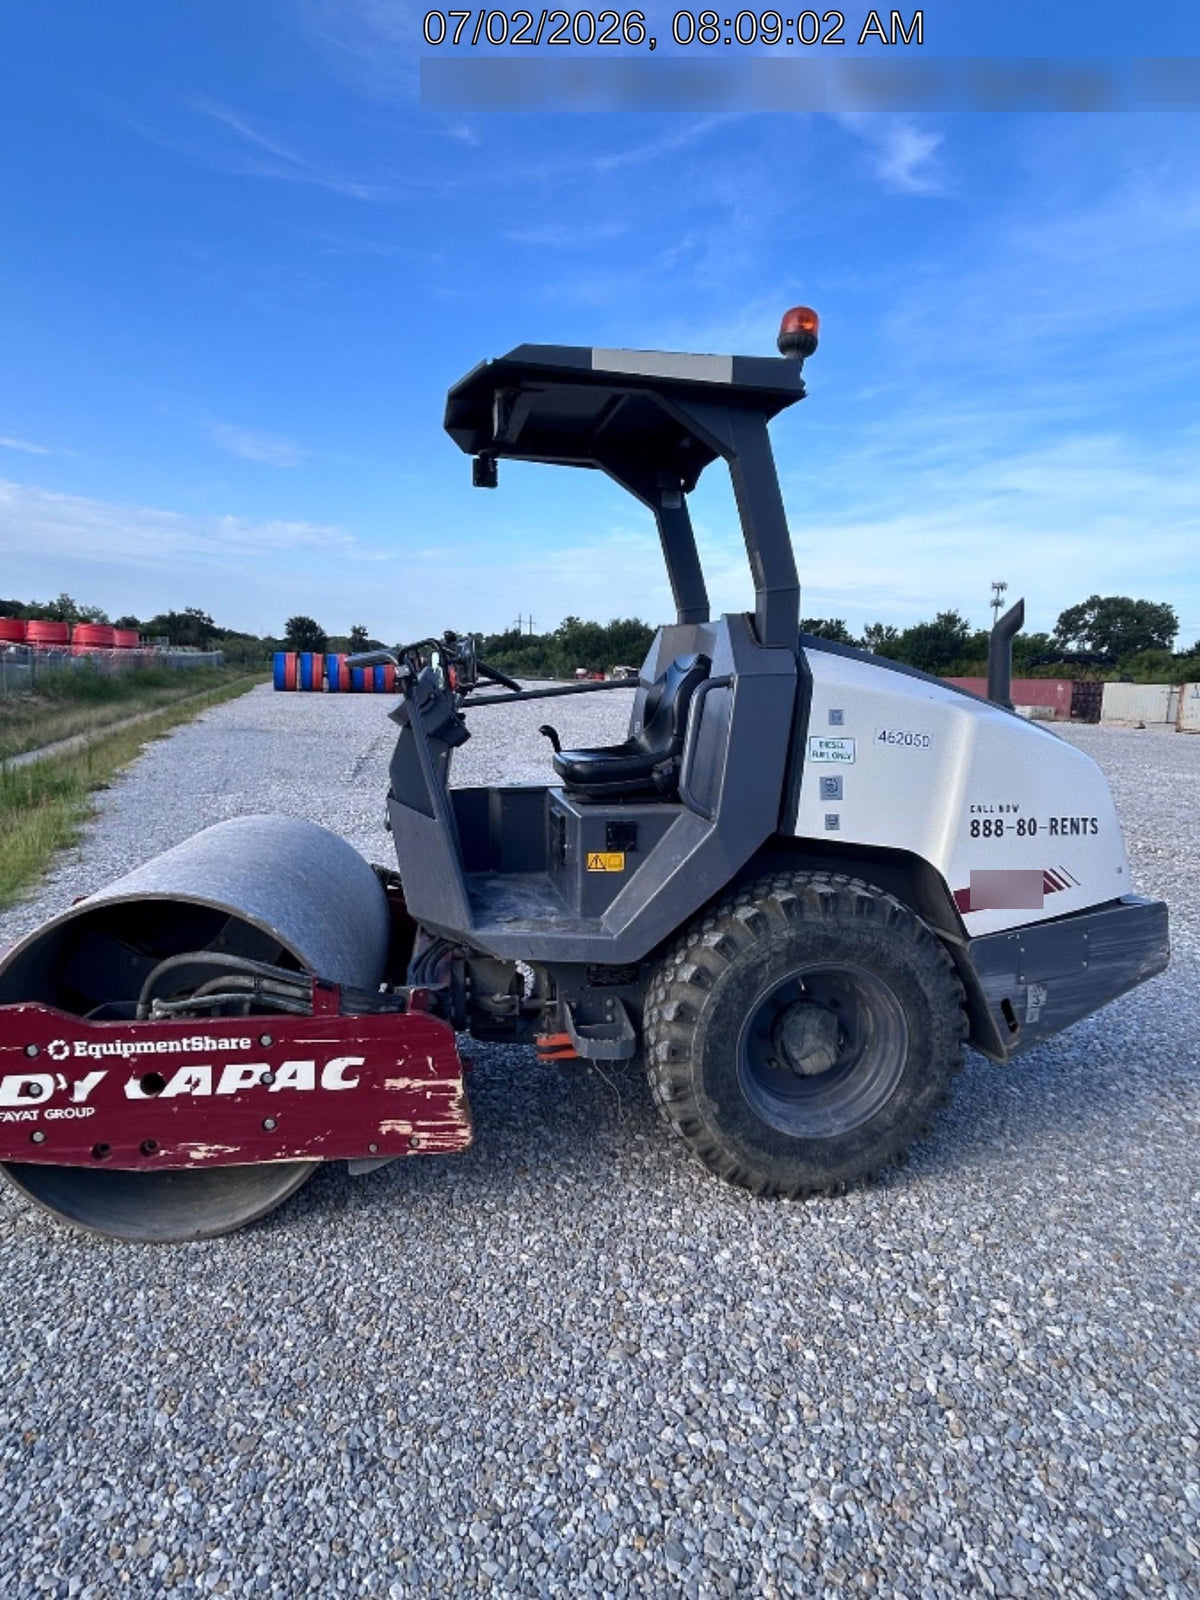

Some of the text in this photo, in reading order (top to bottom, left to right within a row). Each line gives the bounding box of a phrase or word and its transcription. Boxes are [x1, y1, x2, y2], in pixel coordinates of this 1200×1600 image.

[970, 803, 1020, 814] CALL NOW
[969, 816, 1099, 838] 888-80-RENTS
[73, 1035, 252, 1059] EquipmentShare
[0, 1056, 366, 1107] DYAPAC
[44, 1106, 96, 1120] GROUP
